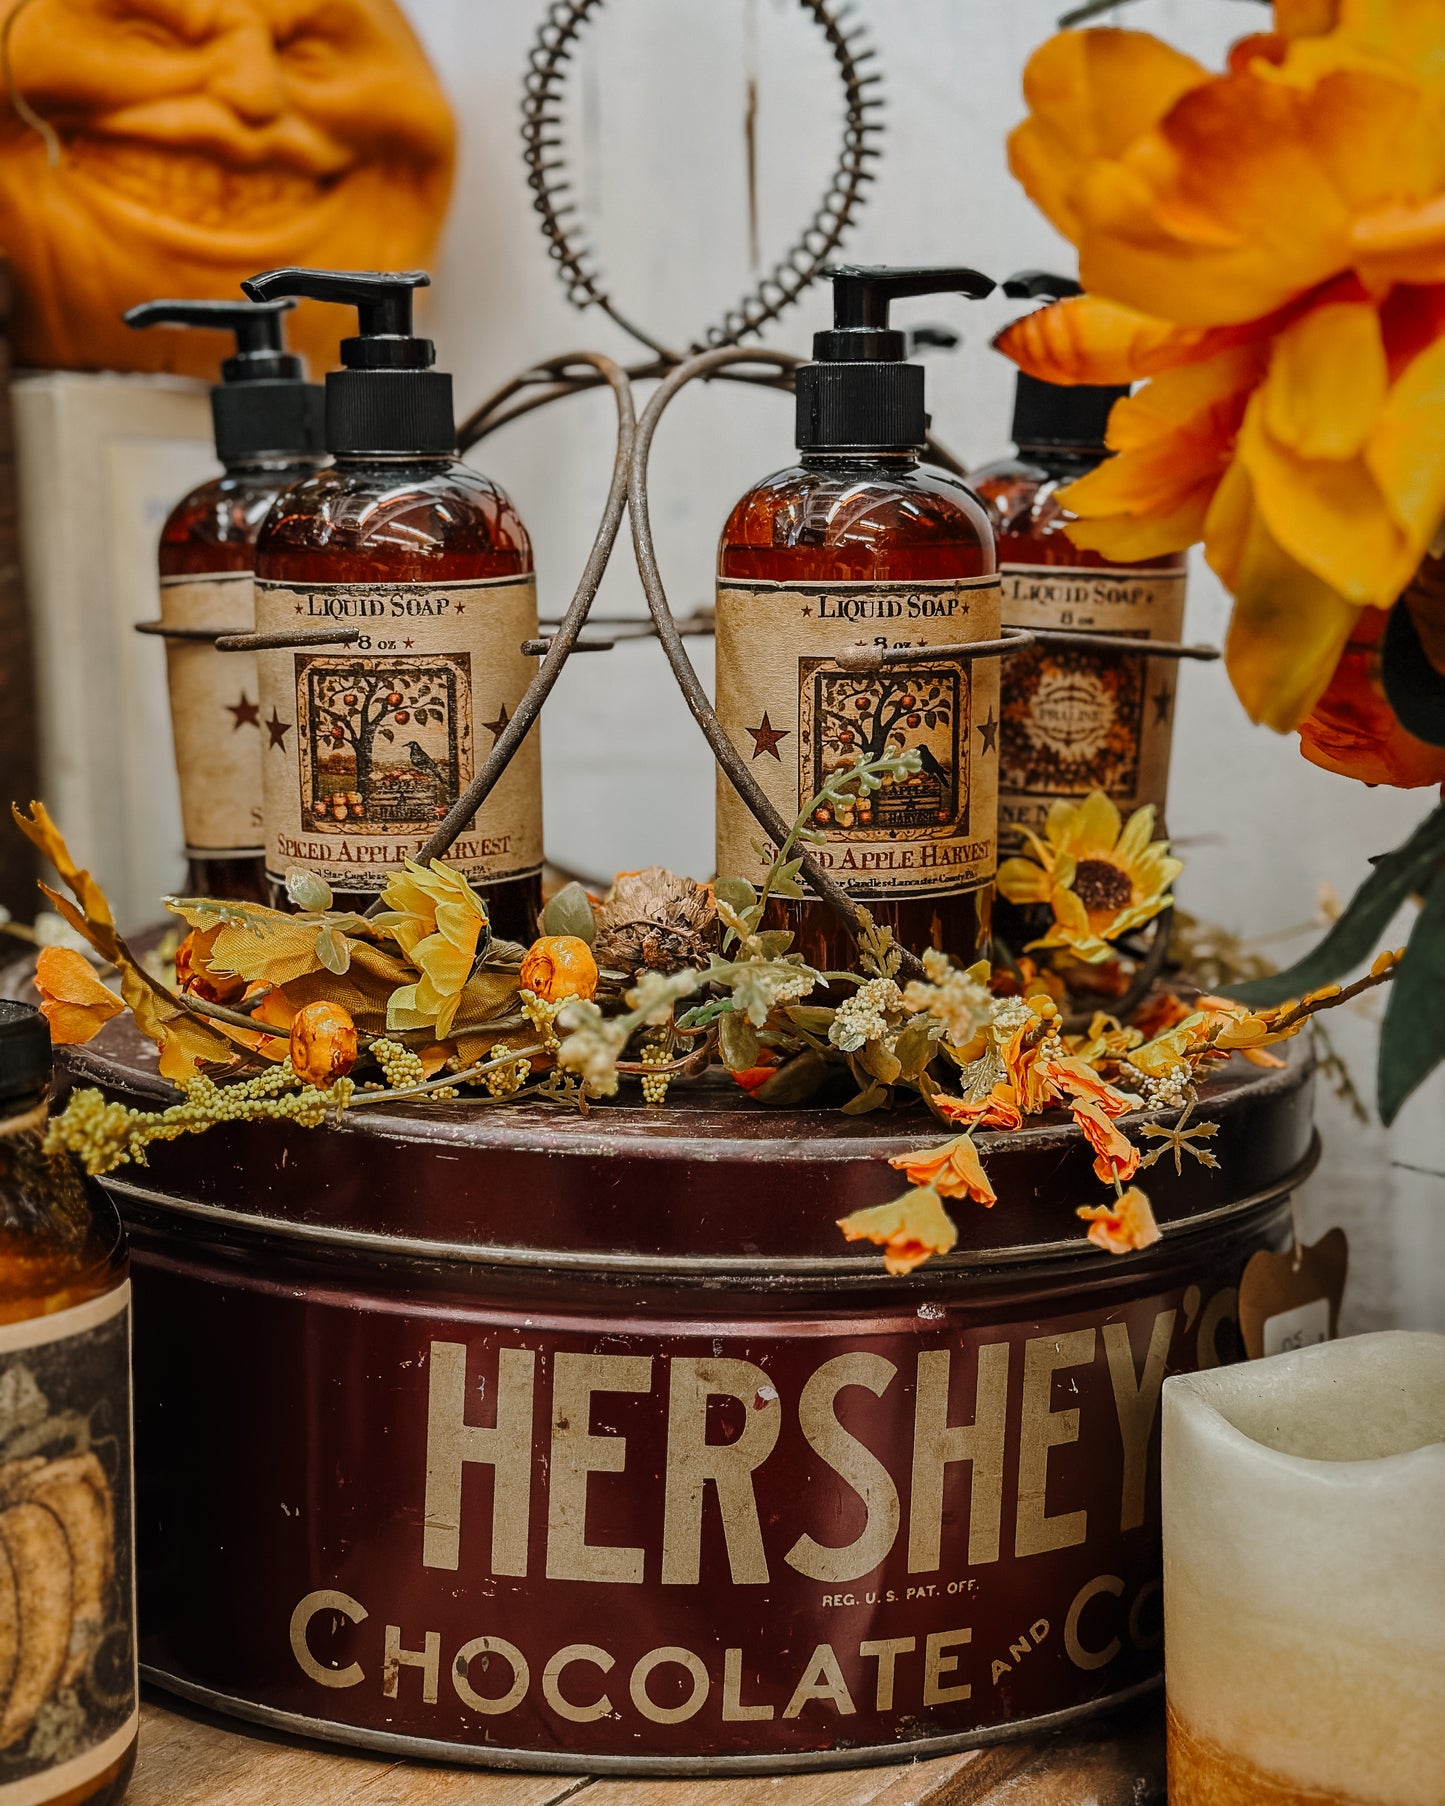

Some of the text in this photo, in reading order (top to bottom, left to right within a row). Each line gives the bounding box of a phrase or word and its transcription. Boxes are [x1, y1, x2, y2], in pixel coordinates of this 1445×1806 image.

[1012, 579, 1145, 606] LIQUID SOAP
[307, 593, 450, 621] LIQUID SOAP
[817, 595, 960, 622] LIQUID SOAP
[1060, 611, 1073, 625] 8
[357, 635, 397, 650] 8 oz
[873, 636, 888, 650] 8
[277, 833, 332, 862] SPICED
[336, 840, 409, 864] APPLE
[841, 845, 914, 870] APPLE
[919, 838, 991, 868] HARVEST
[822, 1578, 980, 1607] REG. U. S. PAT. OFF.
[289, 1588, 974, 1724] CHOCOLATE
[991, 1617, 1050, 1686] AND
